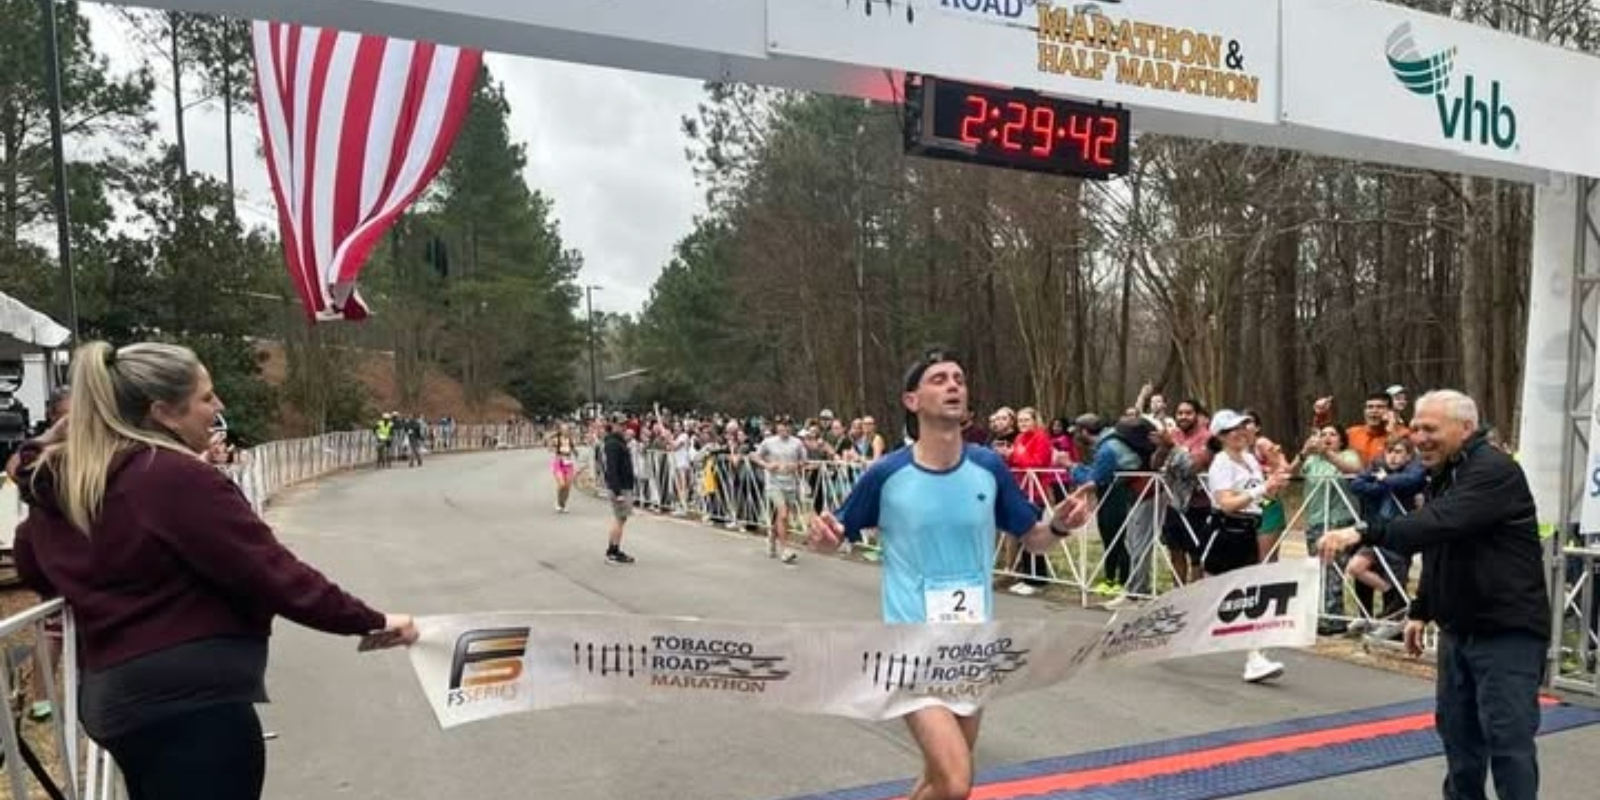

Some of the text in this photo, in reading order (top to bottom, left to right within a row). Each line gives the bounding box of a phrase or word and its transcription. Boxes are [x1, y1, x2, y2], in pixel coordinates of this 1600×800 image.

[1037, 2, 1244, 70] MARATHON &
[1037, 41, 1259, 103] HALF MARATHON
[952, 589, 967, 612] 2
[652, 635, 754, 654] TOBACCO
[652, 655, 710, 671] ROAD
[930, 665, 981, 681] ROAD
[651, 675, 766, 692] MARATHON
